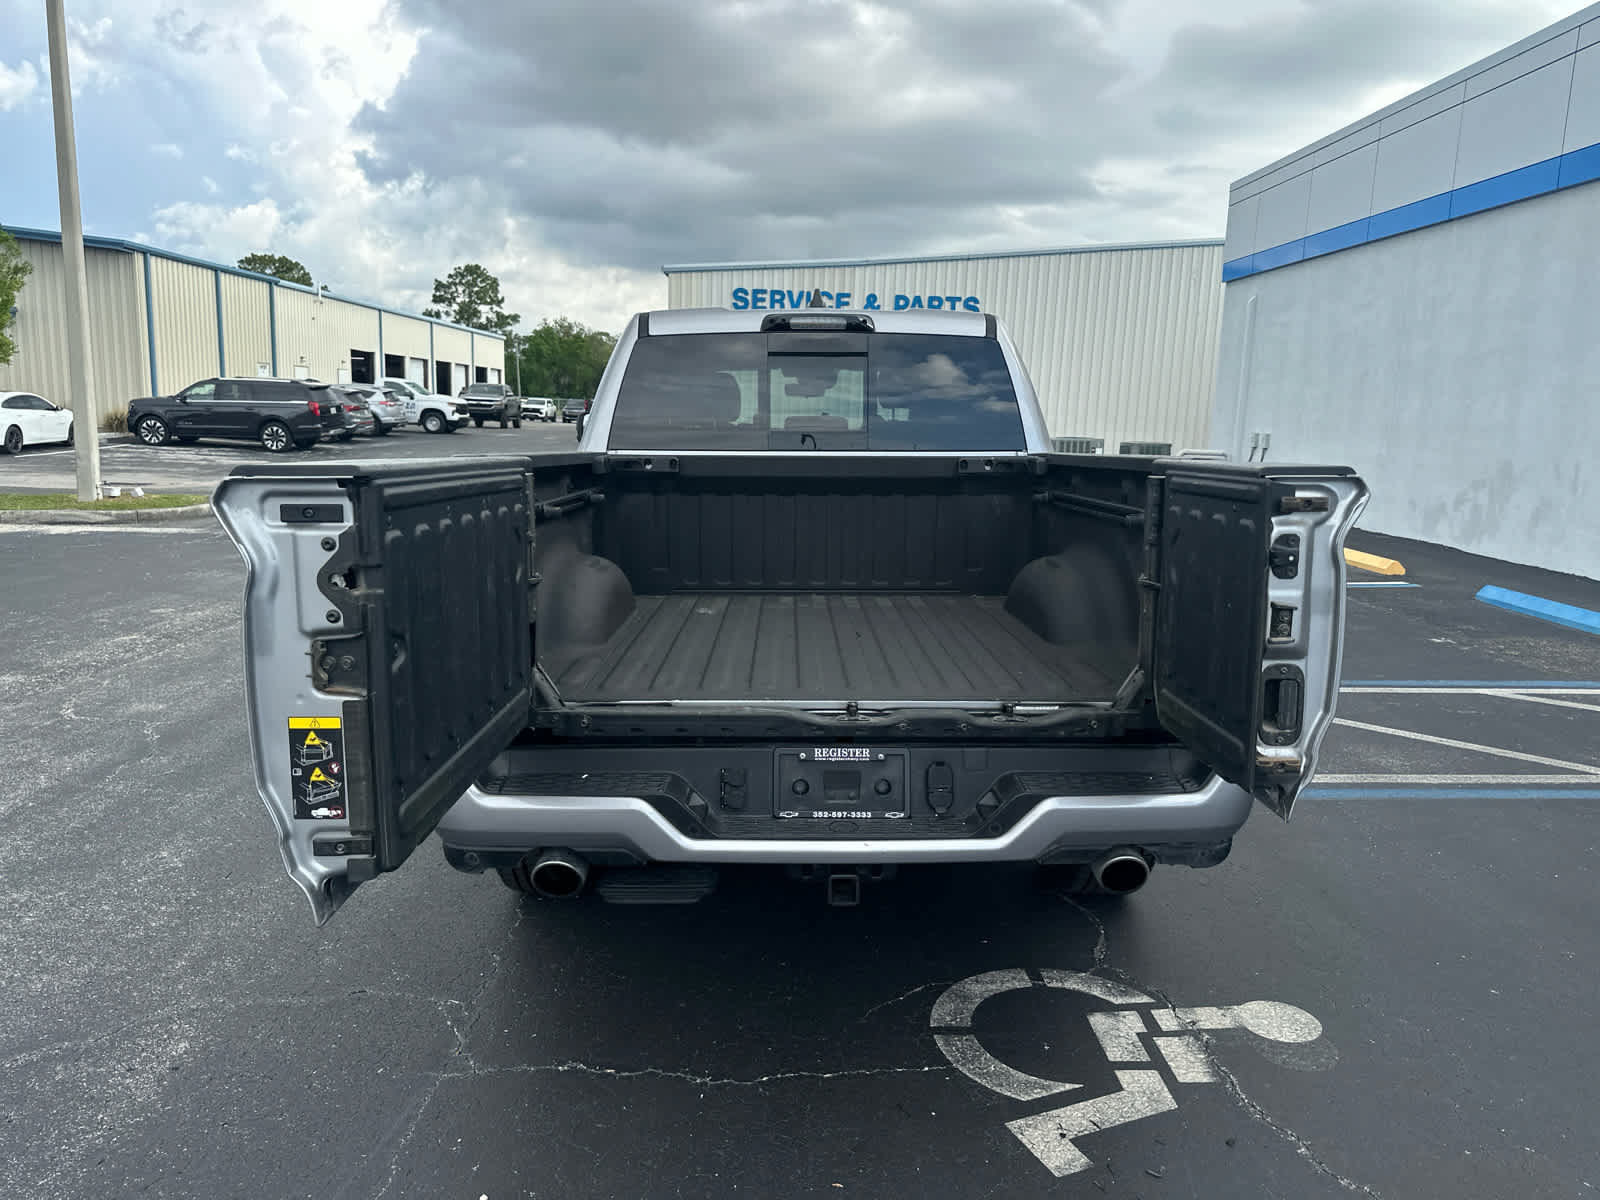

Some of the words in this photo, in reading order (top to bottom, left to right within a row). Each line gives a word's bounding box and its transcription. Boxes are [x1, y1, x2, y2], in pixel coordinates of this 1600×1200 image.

[863, 293, 881, 310] &
[894, 294, 980, 312] PARTS
[814, 748, 871, 757] REGISTER
